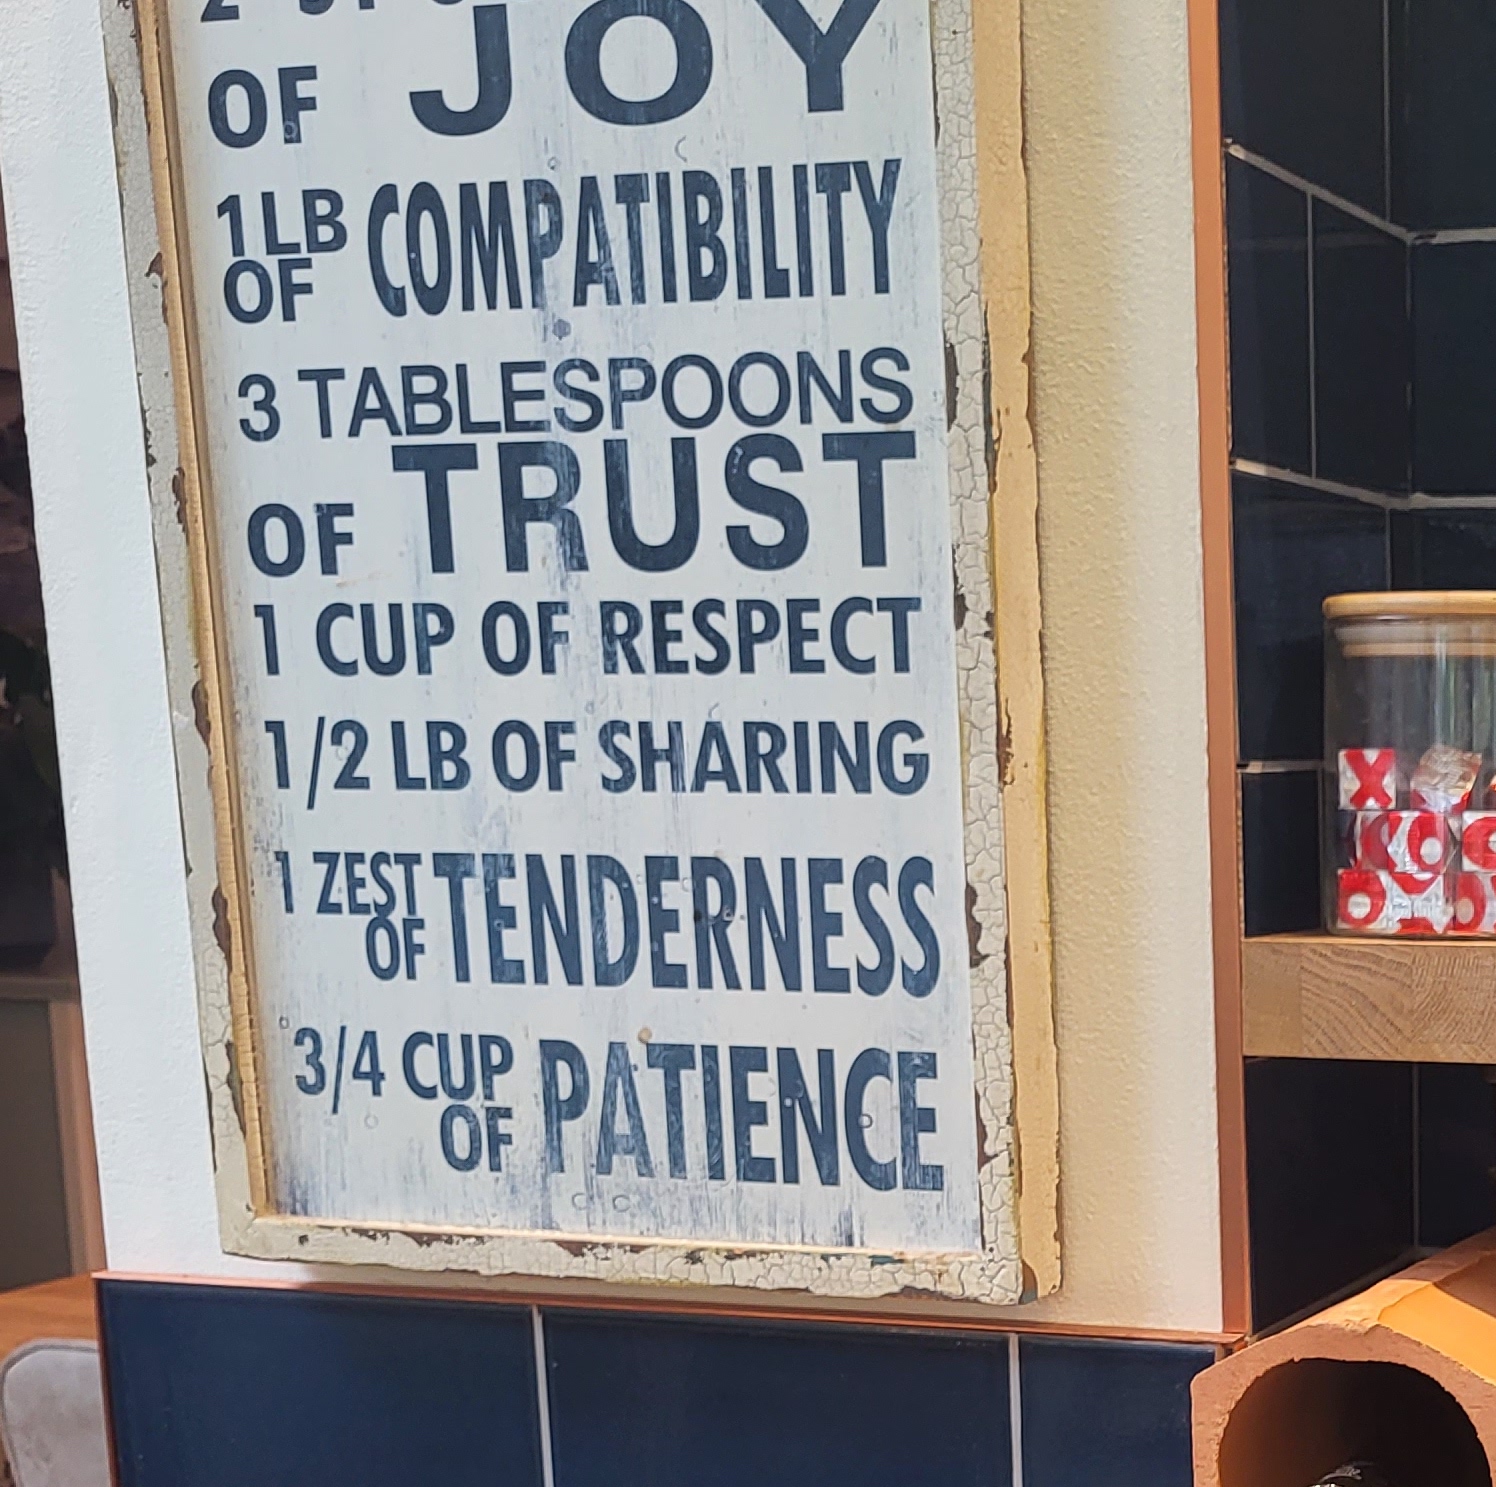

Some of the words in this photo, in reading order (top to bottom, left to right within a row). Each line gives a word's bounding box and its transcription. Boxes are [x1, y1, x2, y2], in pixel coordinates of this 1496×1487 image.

[208, 66, 317, 148] OF
[409, 0, 880, 136] JOY
[368, 159, 901, 317] COMPATIBILITY
[224, 258, 313, 323] OF
[238, 374, 280, 441] 3
[298, 347, 913, 438] TABLESPOONS
[248, 503, 354, 577] OF
[392, 430, 916, 573] TRUST
[254, 605, 279, 675] 1
[316, 603, 454, 676] CUP
[482, 601, 568, 675] OF
[602, 597, 921, 675] RESPECT
[391, 721, 470, 790] LB
[492, 720, 575, 792] OF
[599, 720, 929, 795] SHARING
[274, 851, 293, 913] 1
[313, 852, 421, 916] ZEST
[432, 853, 940, 997] TENDERNESS
[365, 916, 424, 981] OF
[294, 1026, 385, 1114] 3/4
[403, 1032, 513, 1101] CUP
[539, 1039, 943, 1191] PATIENCE
[440, 1105, 512, 1172] OF
